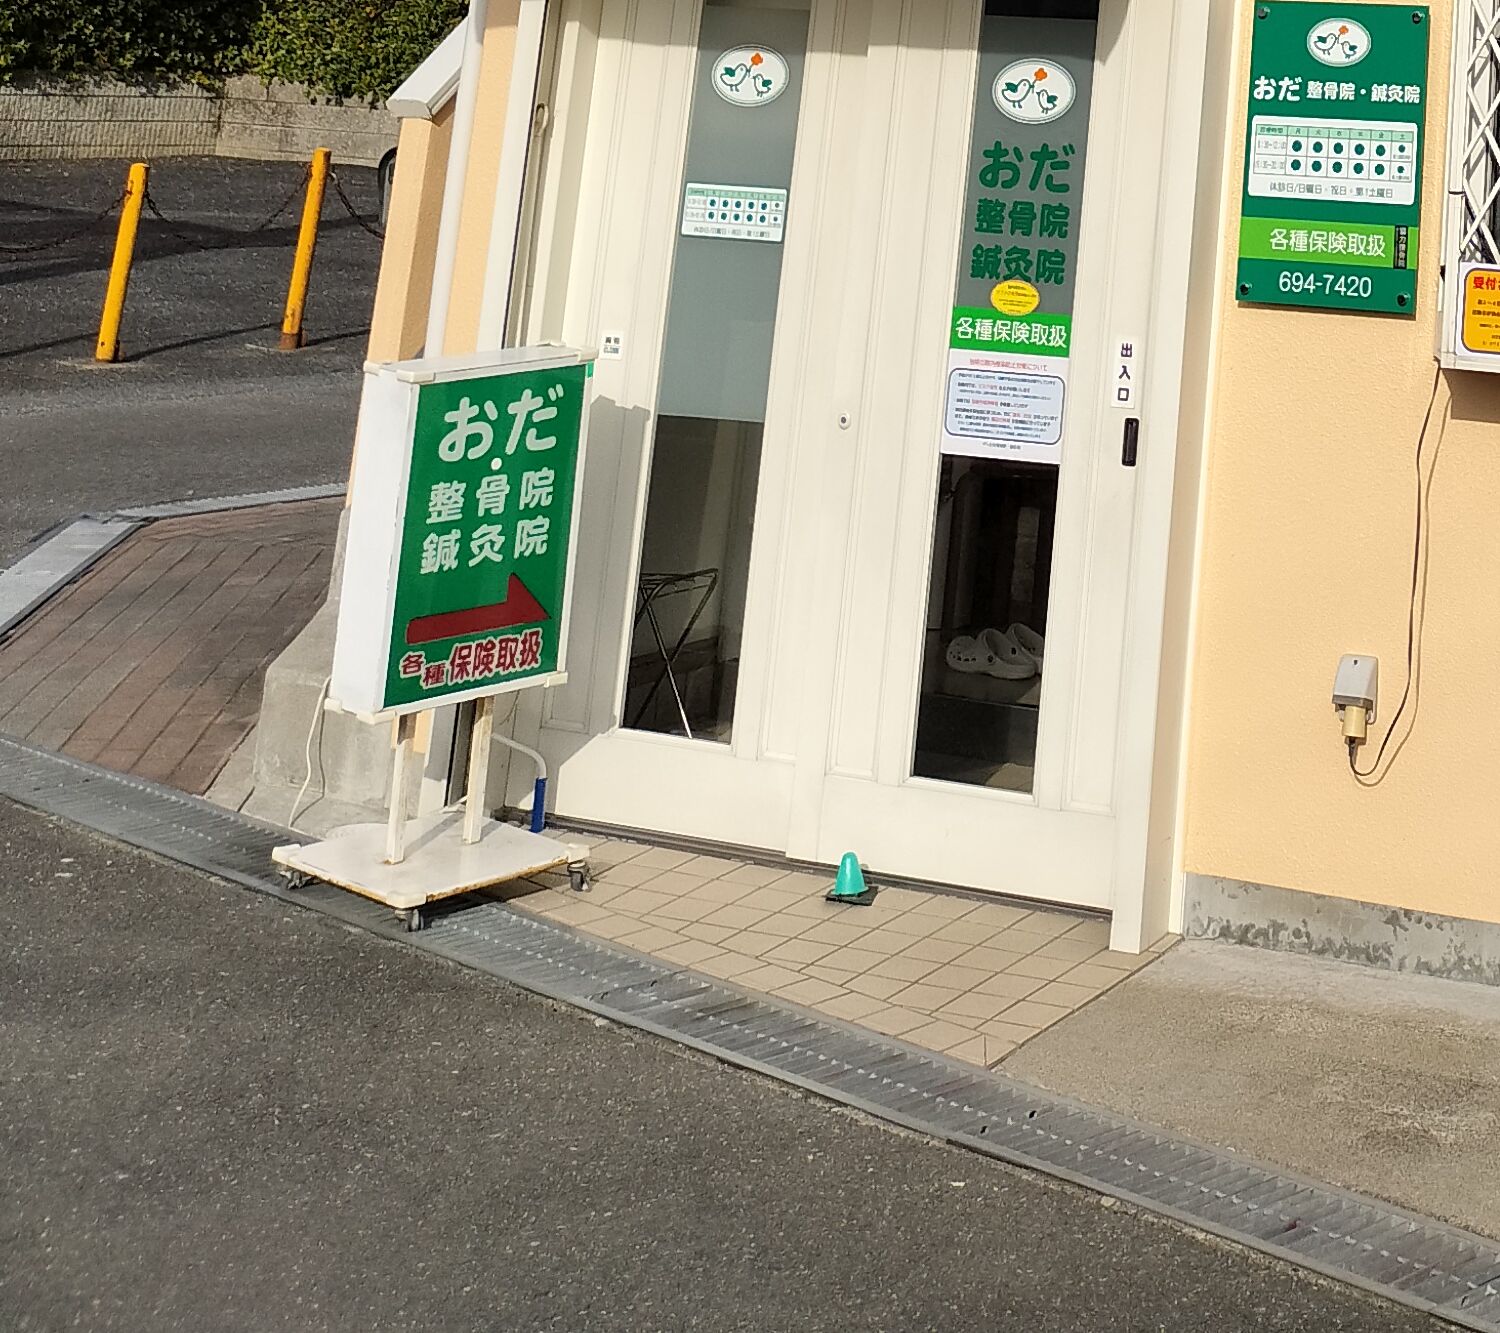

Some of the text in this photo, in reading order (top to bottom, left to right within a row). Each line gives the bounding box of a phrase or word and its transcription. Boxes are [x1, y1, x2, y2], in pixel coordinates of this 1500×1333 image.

[1253, 75, 1421, 104] おだ 整骨院・鍼灸院
[978, 140, 1076, 194] おだ
[974, 197, 1071, 239] 整骨院
[970, 243, 1066, 286] 鍼灸院
[1269, 228, 1386, 258] 各種保険取扱
[1279, 271, 1373, 298] 694-7420
[955, 316, 1068, 349] 各種保険取扱
[1117, 342, 1133, 402] 出入口
[438, 383, 564, 463] おだ
[426, 466, 556, 525] 整骨院
[420, 515, 550, 575] 鍼灸院
